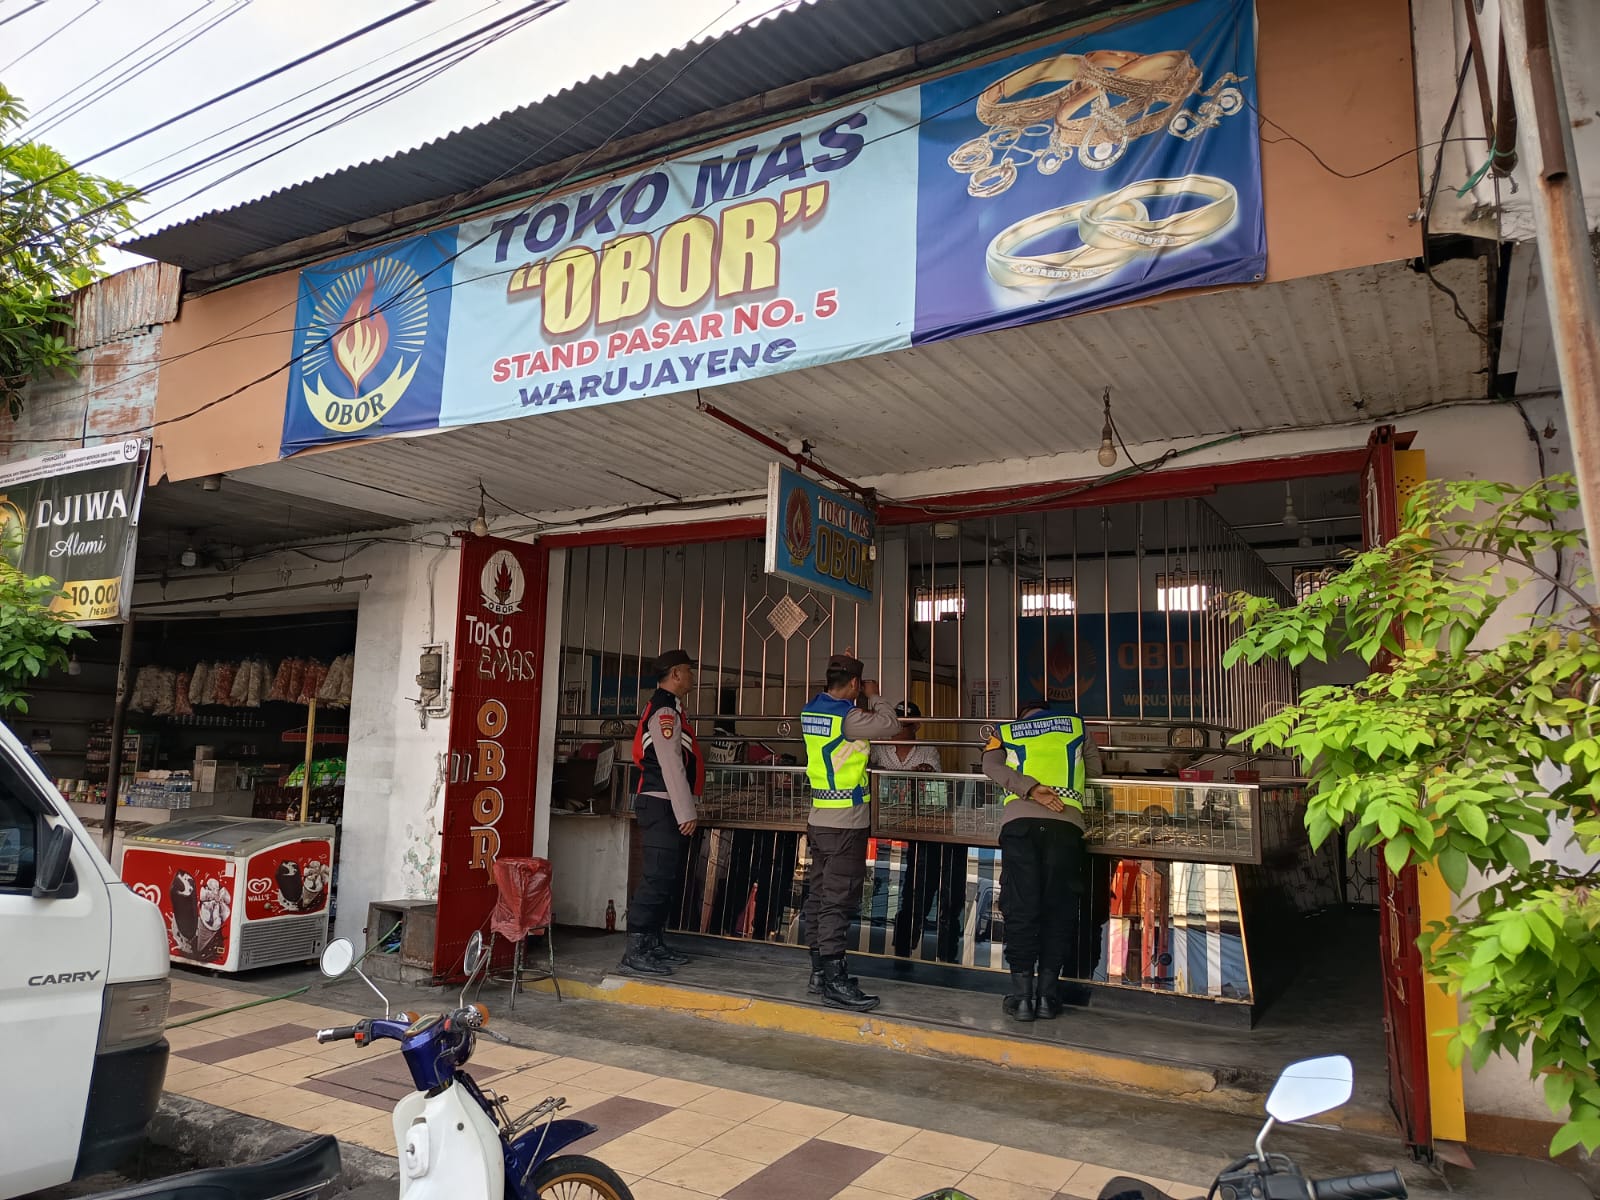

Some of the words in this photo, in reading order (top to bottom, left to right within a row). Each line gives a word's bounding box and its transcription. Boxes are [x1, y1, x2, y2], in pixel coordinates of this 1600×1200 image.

[491, 172, 669, 263] TOKO
[691, 112, 868, 208] MAS
[493, 340, 600, 382] STAND
[607, 313, 723, 359] PASAR
[733, 299, 804, 335] NO.
[815, 289, 838, 318] 5
[518, 338, 797, 407] WARUJAYENG
[325, 392, 386, 425] OBOR
[36, 489, 128, 528] DJIWA
[817, 495, 847, 529] TOKO
[849, 510, 870, 540] MAS
[49, 531, 107, 558] Alami
[465, 615, 512, 648] TOKO
[479, 645, 535, 682] EMAS
[468, 698, 508, 886] OBOR
[28, 969, 101, 987] CARRY
